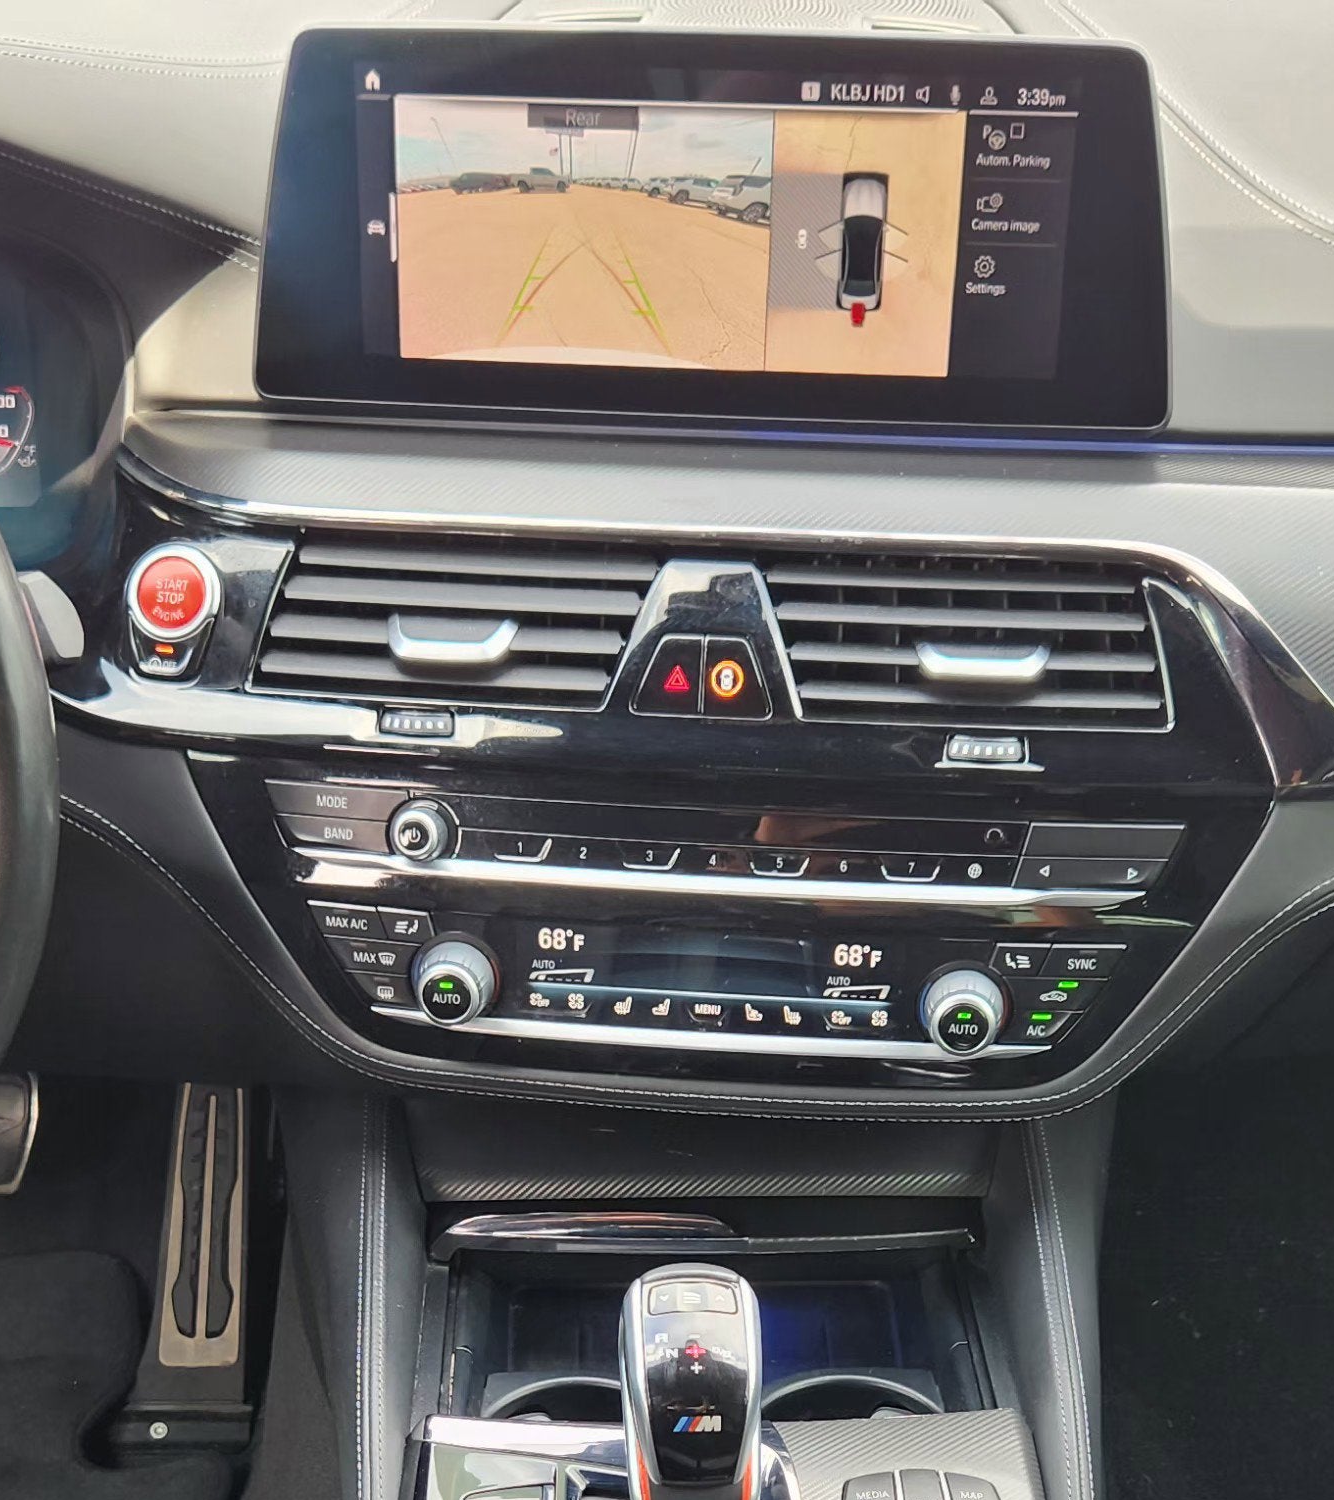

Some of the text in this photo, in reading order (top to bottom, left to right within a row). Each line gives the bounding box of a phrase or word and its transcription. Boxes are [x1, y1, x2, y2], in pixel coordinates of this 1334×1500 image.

[831, 83, 871, 101] KLBJ
[873, 84, 905, 102] HD1
[565, 108, 602, 126] Rear
[975, 153, 1051, 170] Autom. Parking
[971, 218, 1040, 233] Camera image
[965, 282, 1006, 296] Settings
[155, 579, 188, 591] START
[156, 592, 185, 605] STOP
[152, 606, 185, 622] ENGINE
[317, 795, 348, 810] MODE
[324, 827, 353, 841] BAND
[517, 841, 524, 854] 1
[579, 847, 587, 860] 2
[645, 850, 653, 862] 3
[708, 853, 717, 867] 4
[775, 856, 784, 869] 5
[839, 860, 848, 873] 6
[908, 861, 916, 874] 7
[325, 915, 368, 931] MAX A/C
[353, 951, 376, 965] MAX
[531, 958, 557, 970] AUTO
[1067, 957, 1097, 971] SYNC
[825, 975, 852, 987] AUTO
[432, 992, 461, 1006] AUTO
[694, 1003, 722, 1017] MENU
[948, 1023, 978, 1036] AUTO
[1026, 1024, 1046, 1037] A/C
[856, 1490, 890, 1500] MEDIA
[960, 1490, 984, 1500] MAP
